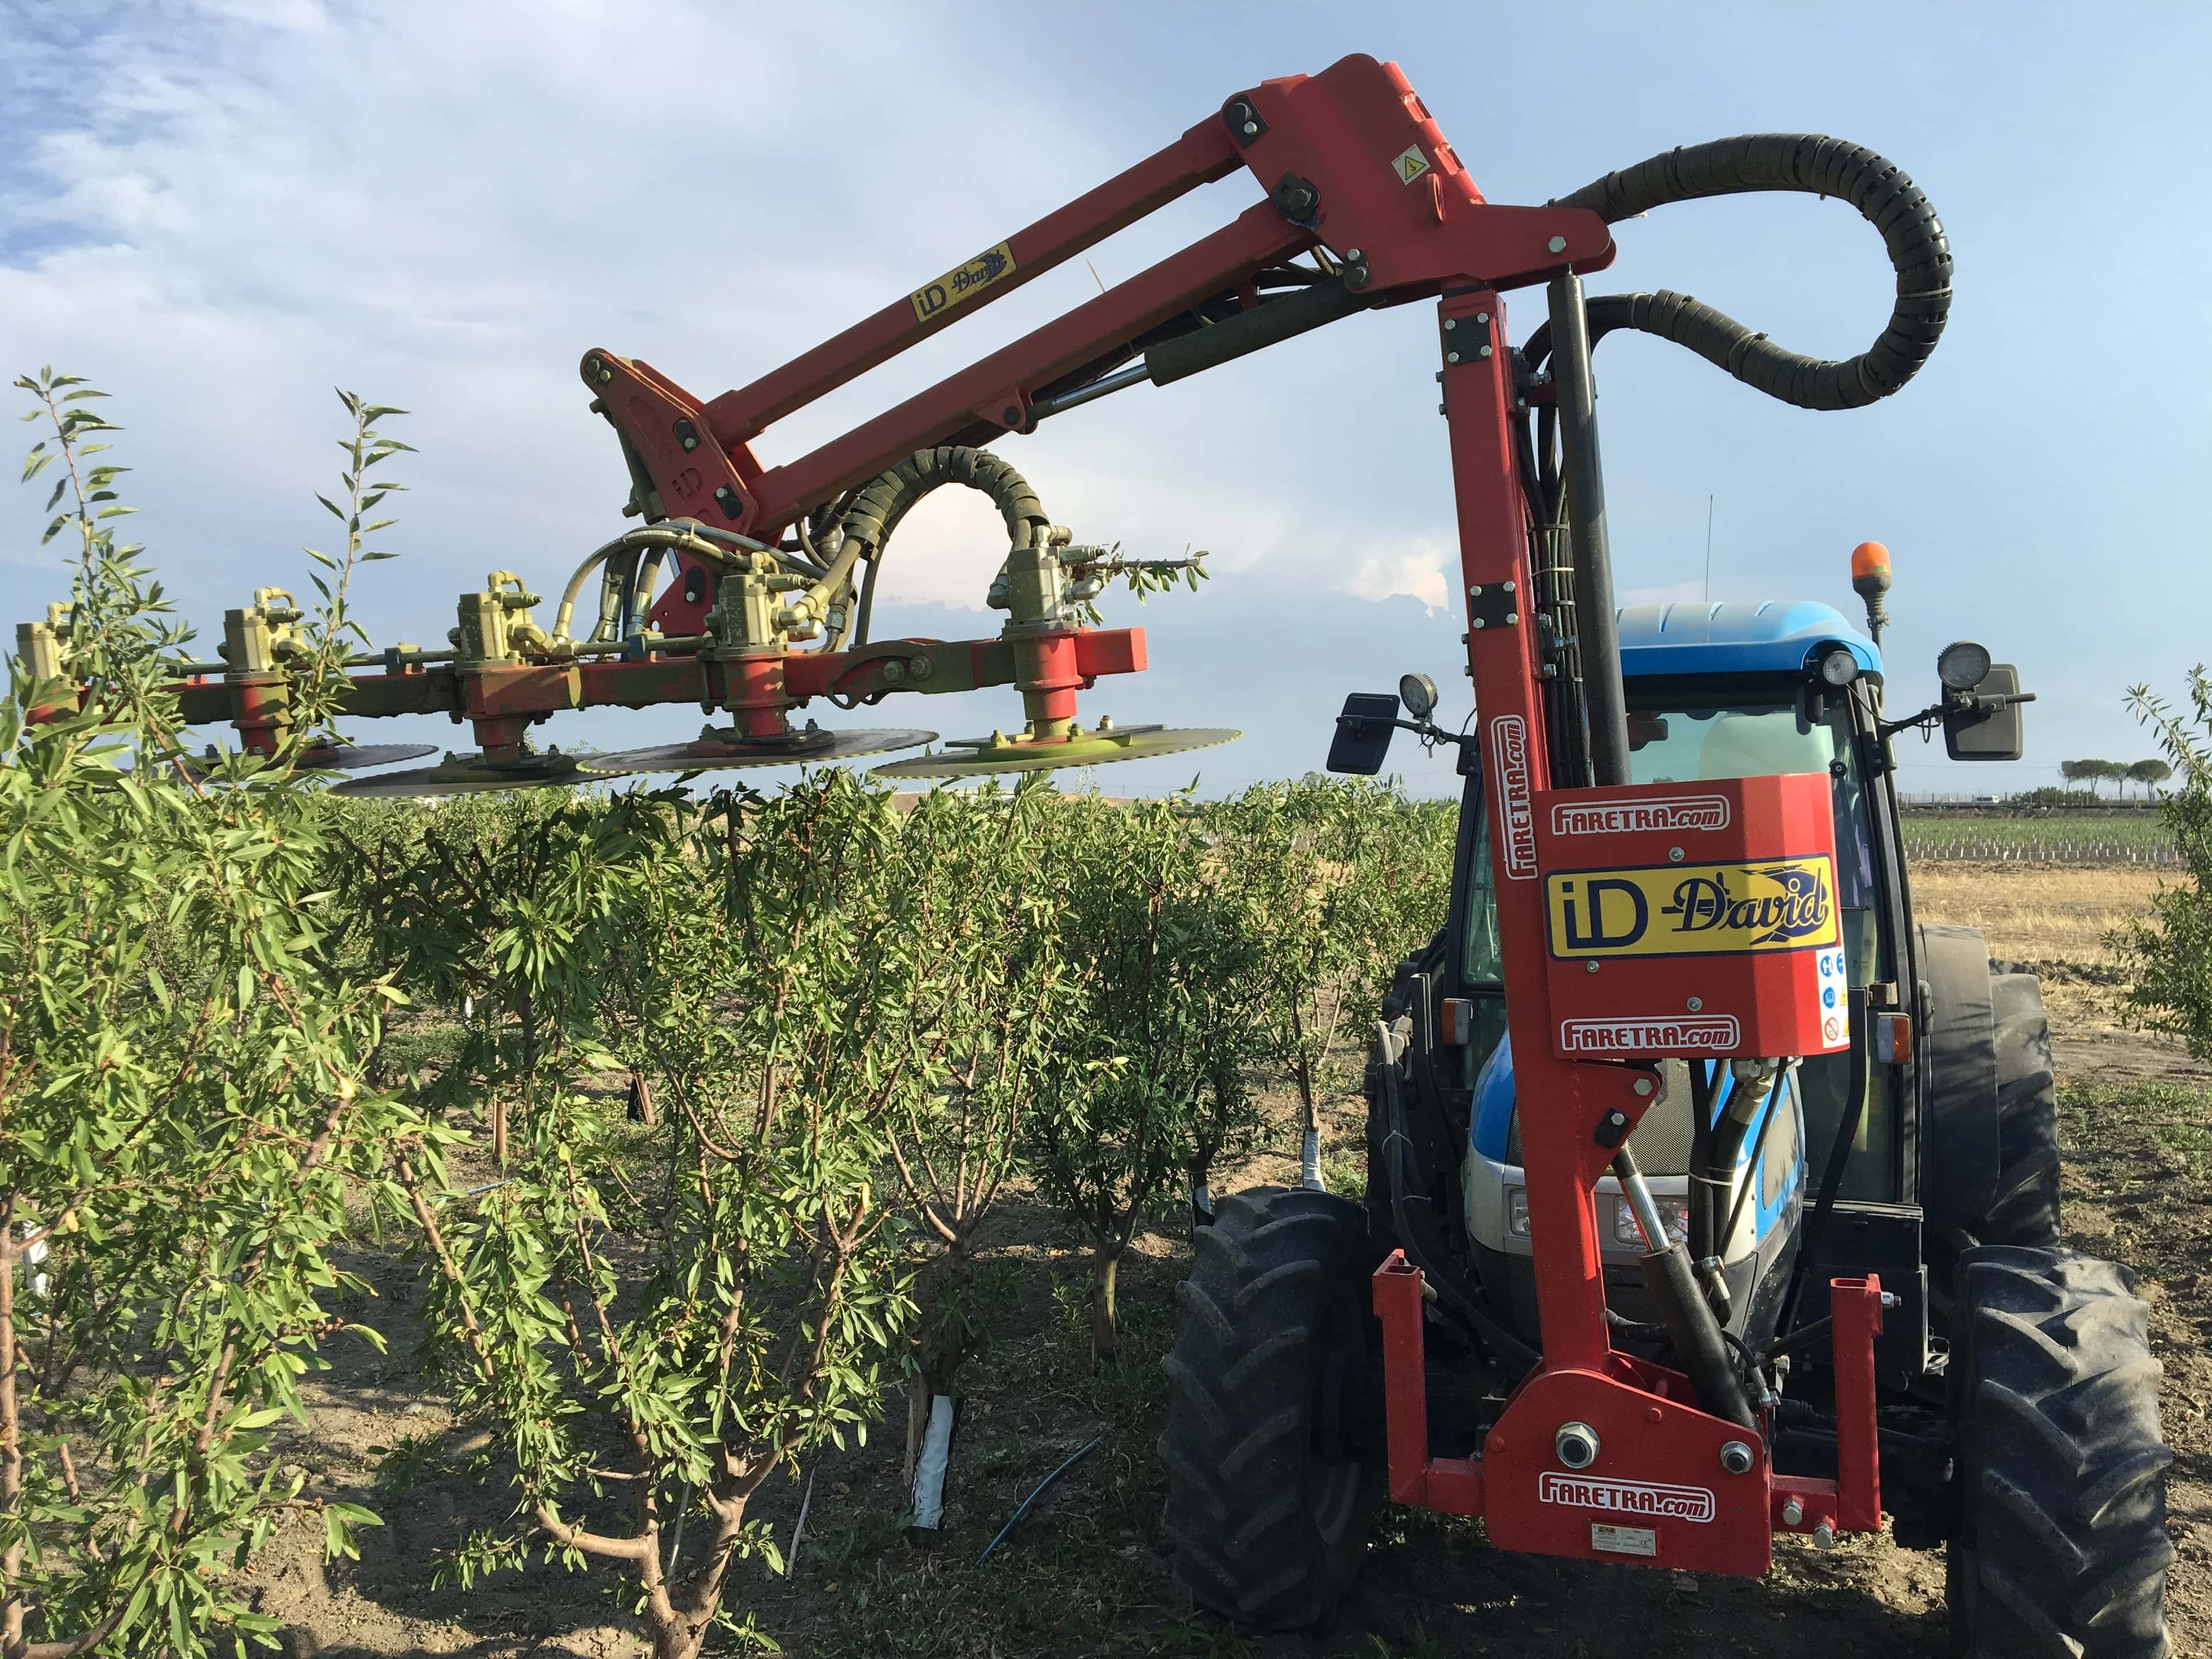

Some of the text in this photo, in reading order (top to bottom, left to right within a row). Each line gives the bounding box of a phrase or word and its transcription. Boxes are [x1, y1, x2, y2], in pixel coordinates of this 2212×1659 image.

[916, 285, 947, 316] iD
[1494, 718, 1537, 878] FARETRA.com
[1553, 798, 1727, 834] FARETRA.com
[1561, 878, 1649, 949] iD
[1563, 1017, 1736, 1048] FARETRA.com
[1541, 1474, 1713, 1520] FARETRA.com
